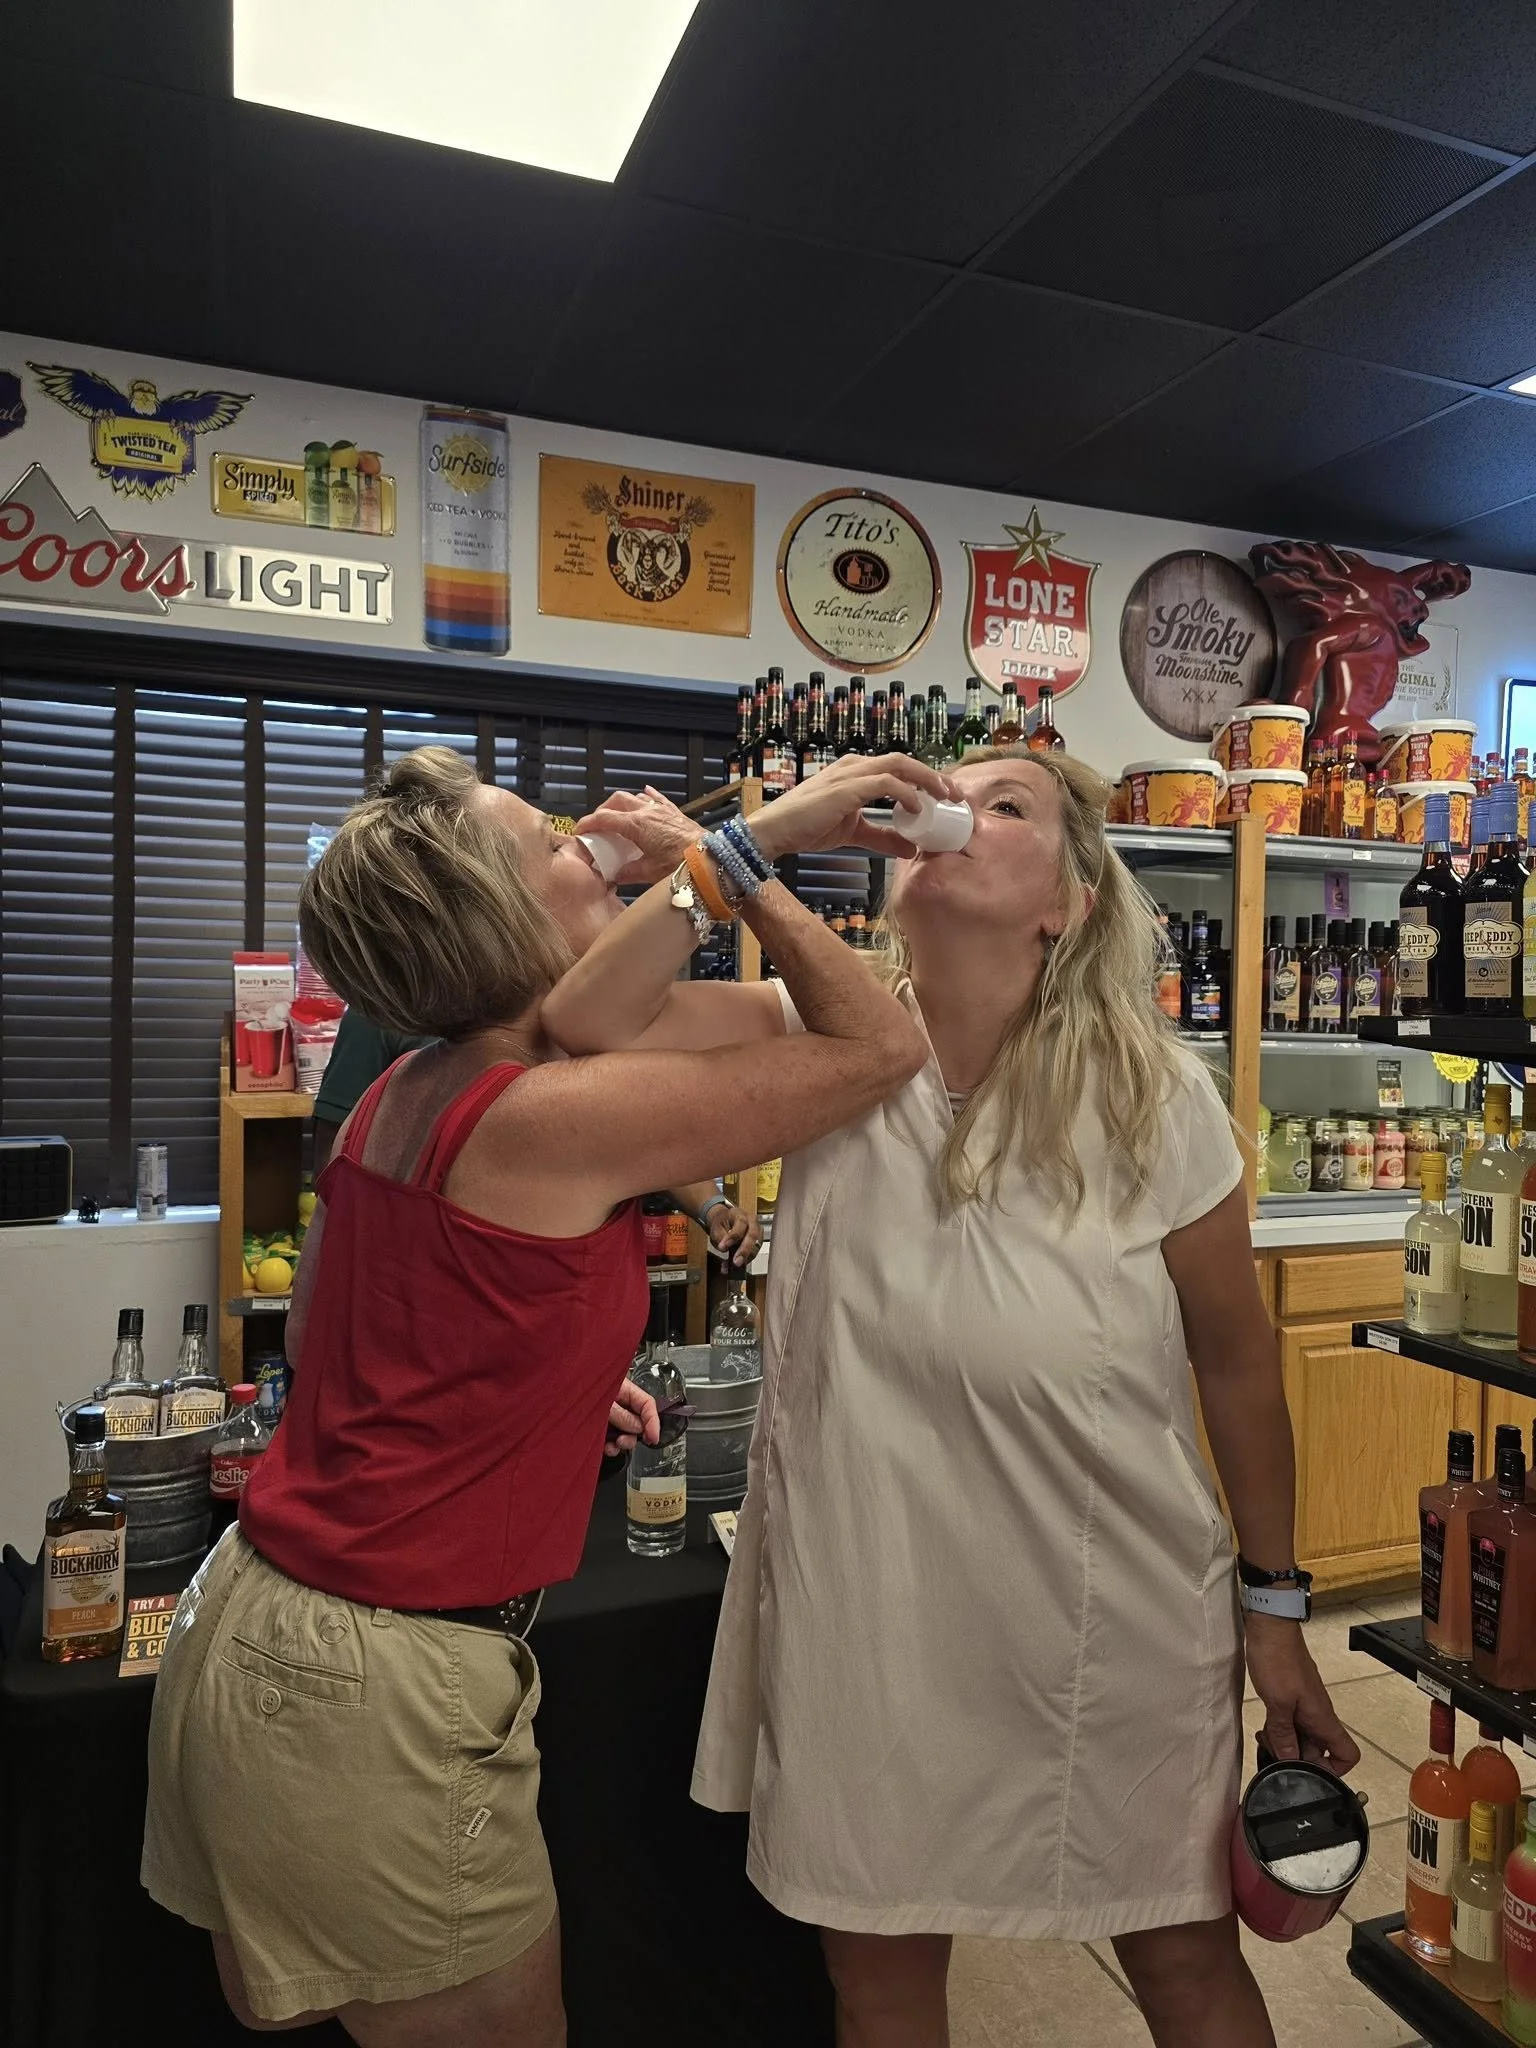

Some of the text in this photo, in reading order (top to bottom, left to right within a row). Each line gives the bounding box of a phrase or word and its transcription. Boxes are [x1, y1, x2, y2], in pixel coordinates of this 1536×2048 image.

[111, 436, 156, 449] TWISTED
[157, 439, 176, 455] TEA
[428, 444, 506, 478] Surfside
[223, 462, 298, 501] Simply
[245, 491, 275, 503] SPIKED
[615, 475, 686, 512] Shiner
[427, 502, 444, 512] ICED
[446, 504, 468, 516] TEA
[477, 510, 507, 521] VODKA
[825, 512, 900, 545] Tito's
[0, 503, 390, 616] Coors LIGHT
[610, 561, 686, 601] Bock Beer
[985, 573, 1075, 618] LONE
[813, 597, 909, 625] Handmade
[1190, 597, 1225, 628] Ole
[837, 626, 885, 640] VODKA
[984, 615, 1074, 657] STAR
[1146, 603, 1256, 667] Smoky
[1155, 654, 1244, 688] Moonshine
[1400, 663, 1416, 672] THE
[1396, 672, 1437, 687] IGINAL
[1407, 934, 1429, 944] EDDY
[1487, 931, 1514, 942] EDDY
[1461, 1192, 1493, 1208] ESTERN
[1521, 1203, 1536, 1216] WES
[1461, 1204, 1493, 1248] ON
[1404, 1248, 1431, 1276] SON
[721, 1327, 746, 1337] 6666
[256, 1363, 284, 1382] Lopez
[105, 1418, 154, 1433] UCKHORN
[166, 1410, 222, 1426] BUCKHORN
[211, 1463, 249, 1483] Leslie
[1450, 1467, 1472, 1478] WHITN
[645, 1496, 683, 1508] VODKA
[1497, 1487, 1512, 1497] TNEY
[50, 1551, 119, 1576] BUCKHORN
[1472, 1571, 1501, 1591] WHITNEY
[133, 1598, 165, 1611] TRY A
[72, 1609, 97, 1621] PEACH
[128, 1615, 176, 1637] BUC
[127, 1639, 167, 1659] & CO
[1409, 1806, 1438, 1831] STERN
[1408, 1818, 1439, 1869] ON
[1504, 1889, 1536, 1926] EDK
